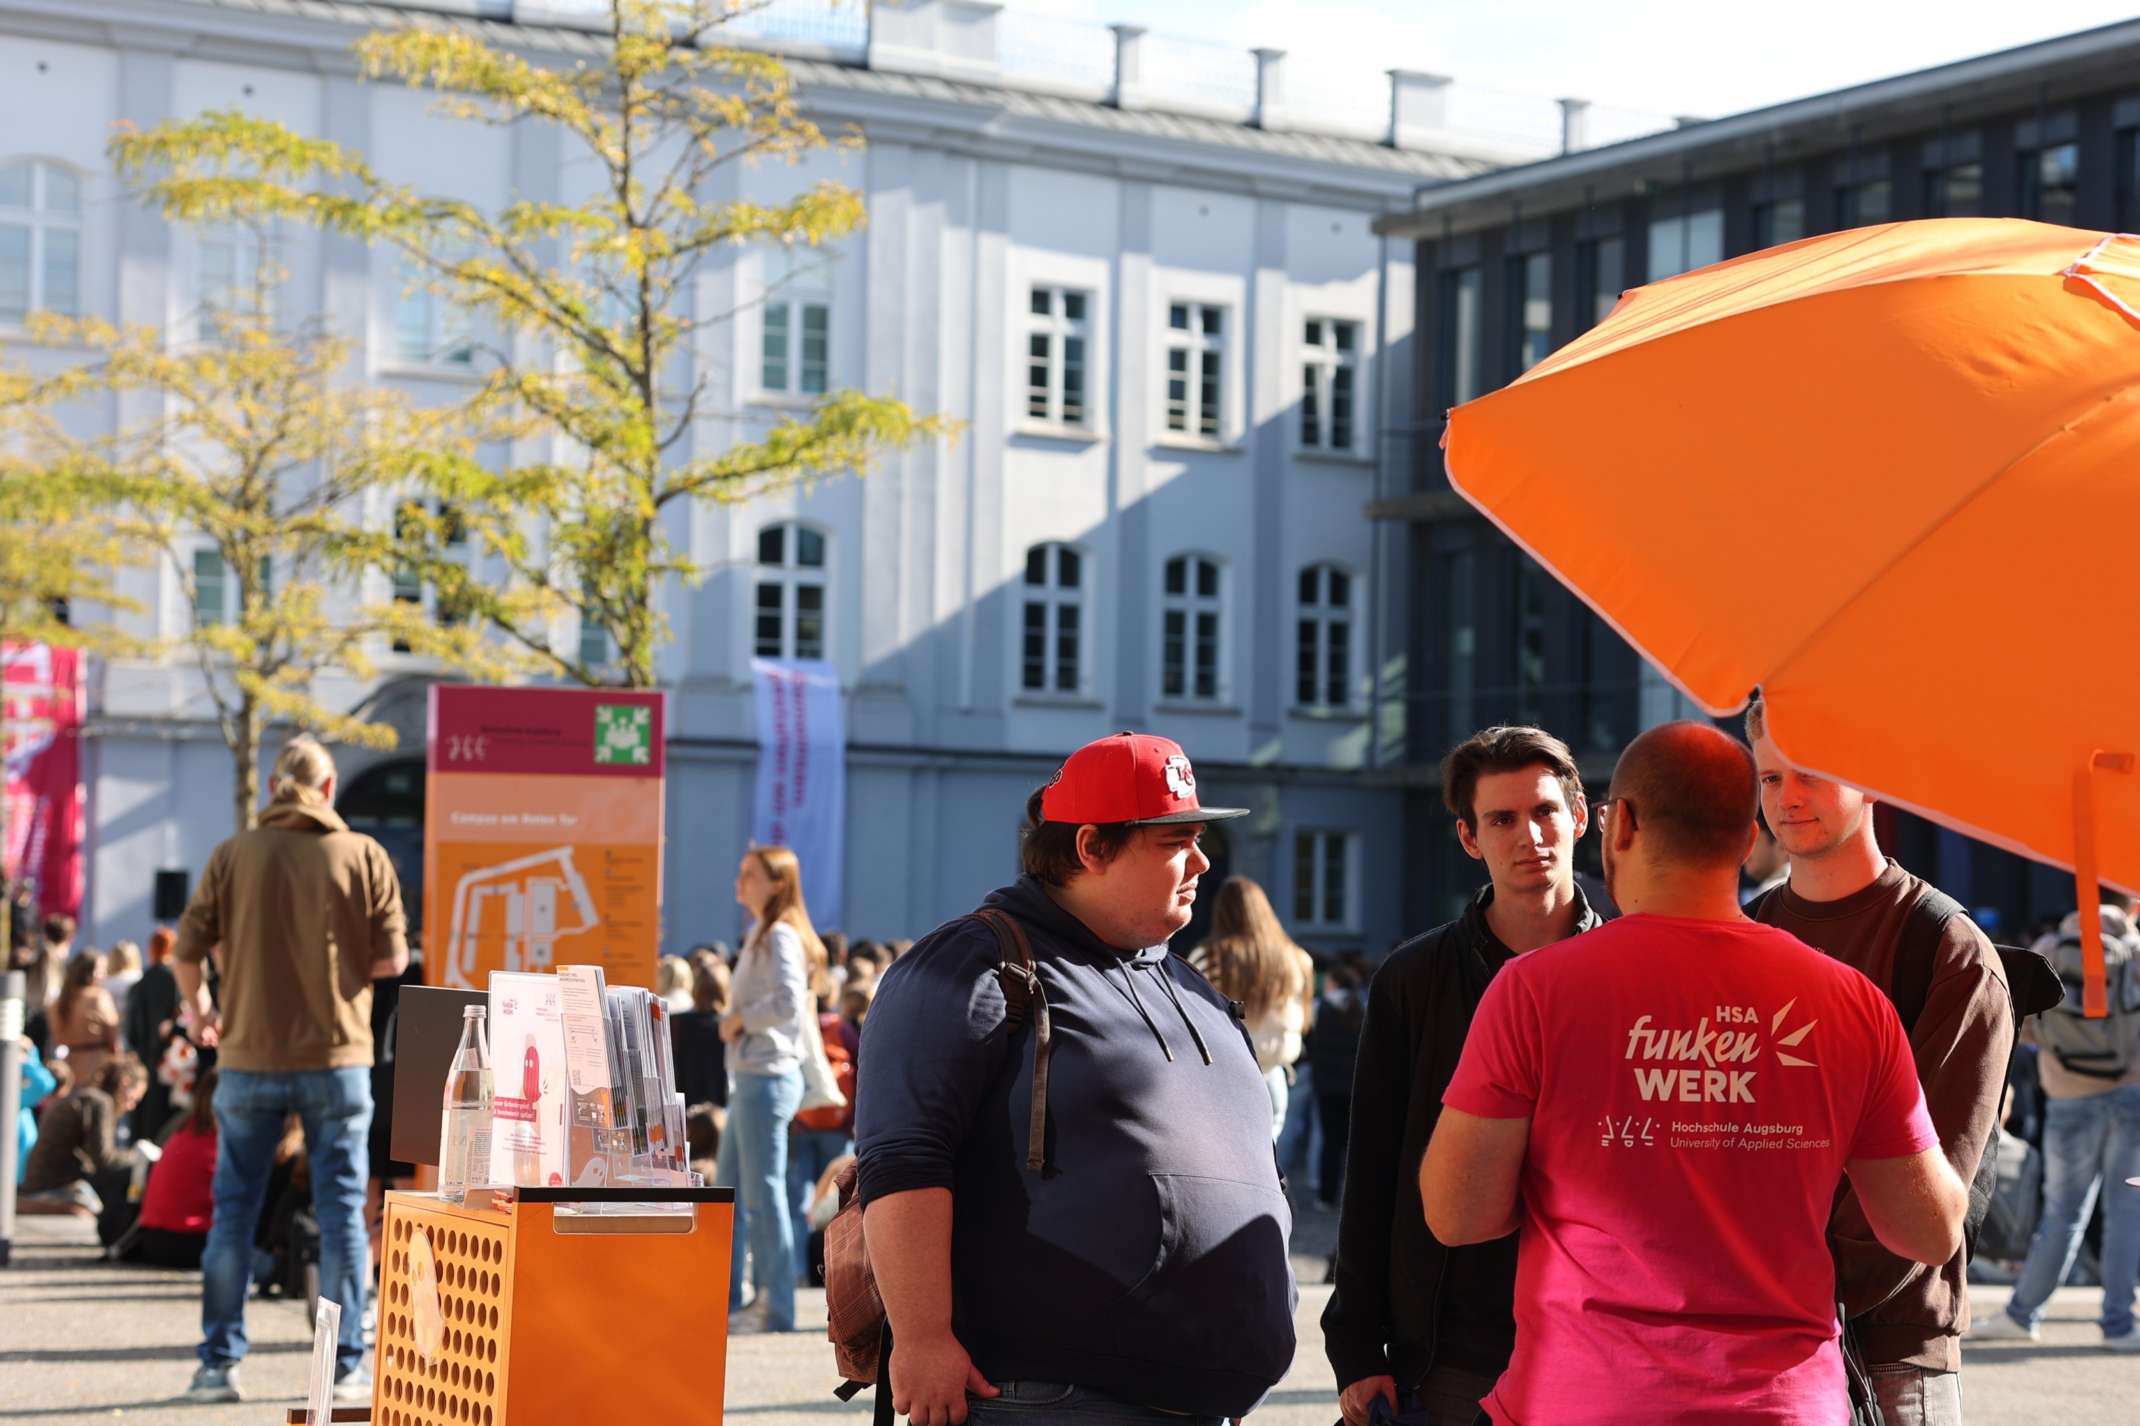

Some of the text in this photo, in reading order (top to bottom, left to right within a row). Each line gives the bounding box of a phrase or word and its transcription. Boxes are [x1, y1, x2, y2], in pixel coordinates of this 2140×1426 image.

[1716, 1006, 1759, 1023] HSA
[1625, 1015, 1760, 1068] funken
[1634, 1068, 1757, 1103] WERK
[1672, 1121, 1803, 1135] Hochschule Augsburg
[1670, 1137, 1831, 1151] University of Applied Sciences
